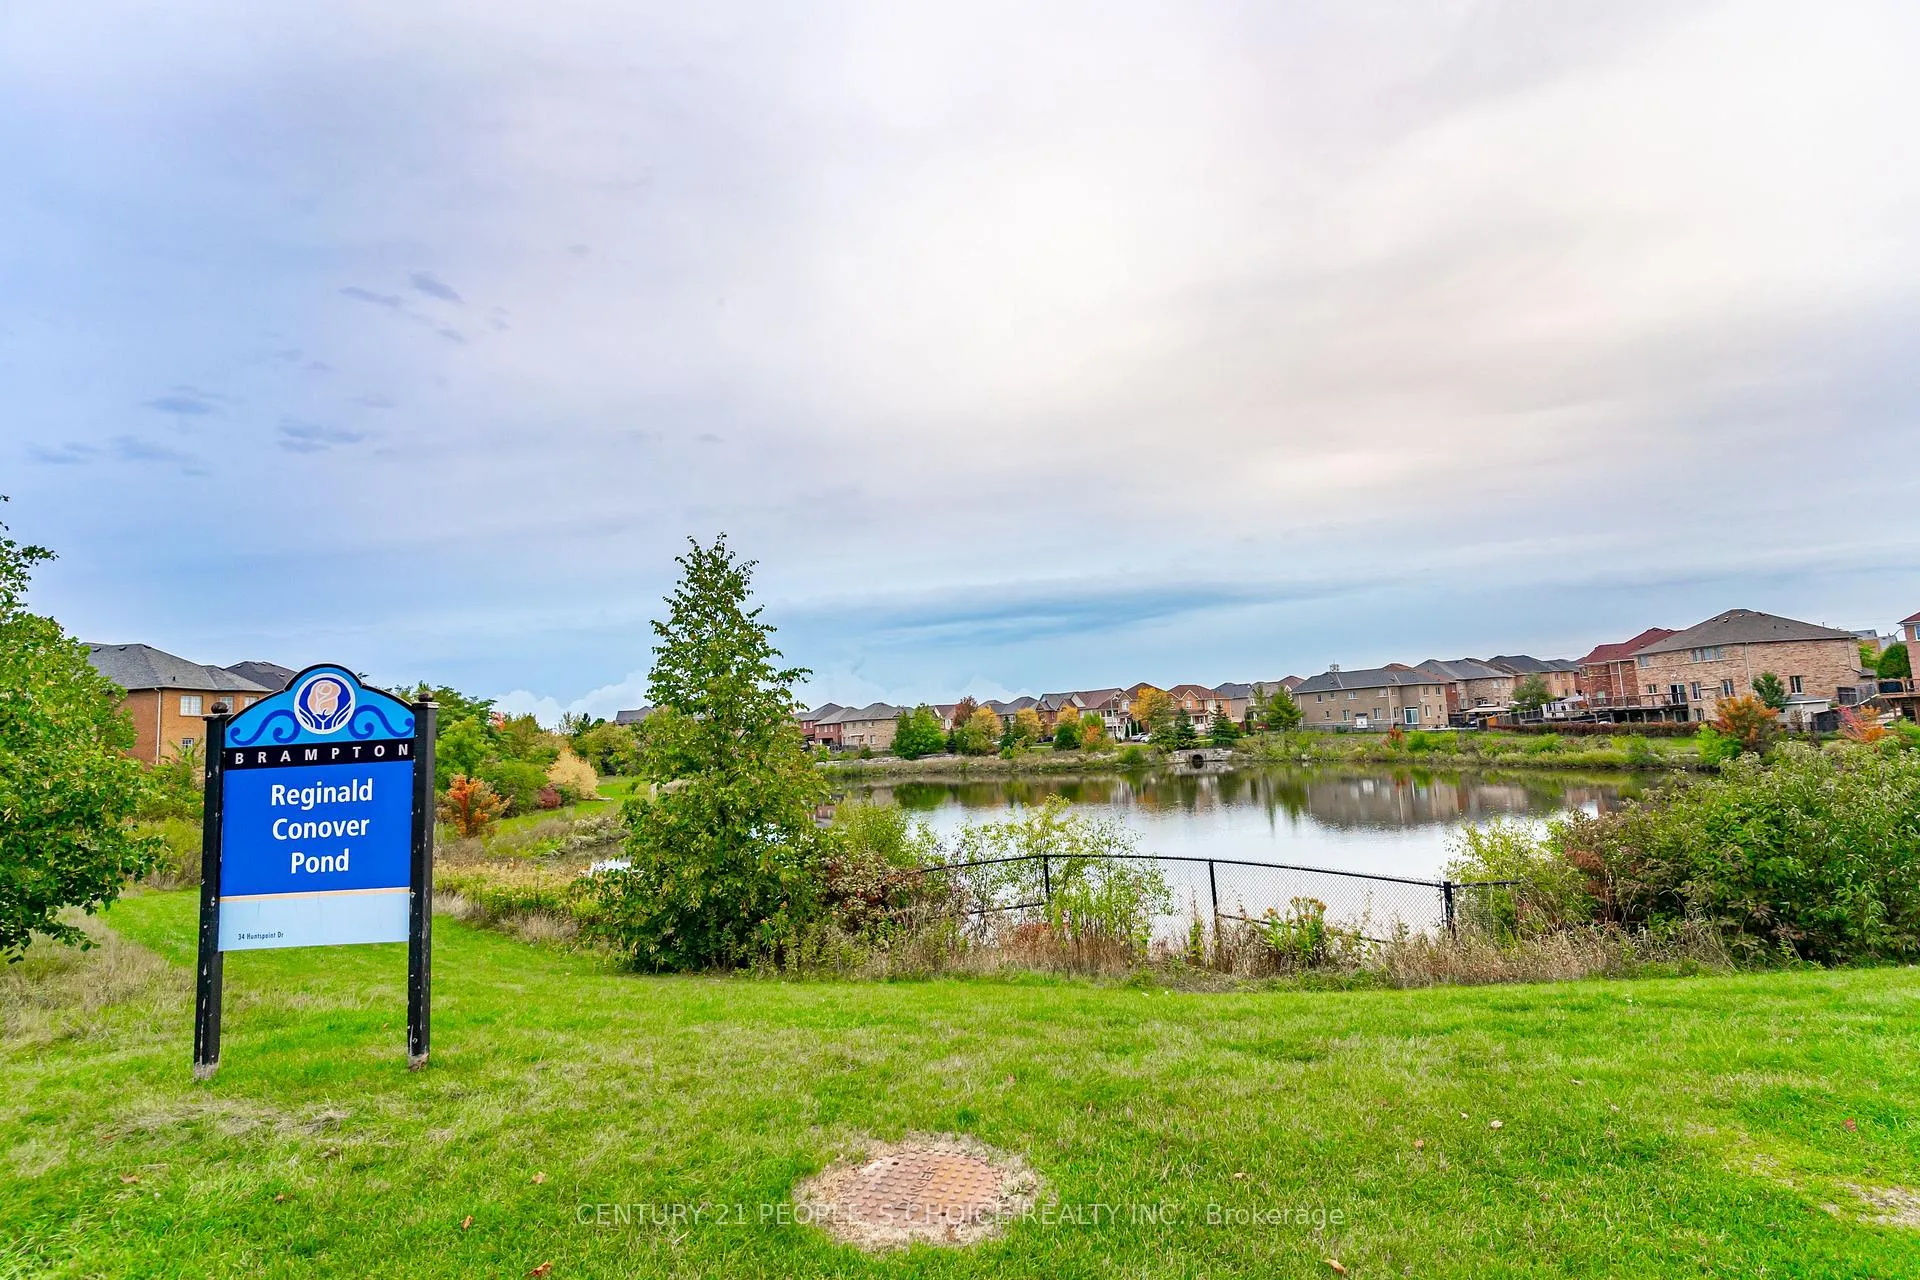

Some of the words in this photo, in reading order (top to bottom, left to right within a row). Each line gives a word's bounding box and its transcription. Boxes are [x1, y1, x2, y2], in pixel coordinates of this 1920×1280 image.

[234, 743, 409, 765] BRAMPTON
[271, 778, 373, 810] Reginald
[272, 817, 370, 840] Conover
[291, 848, 349, 874] Pond
[238, 933, 245, 941] 34
